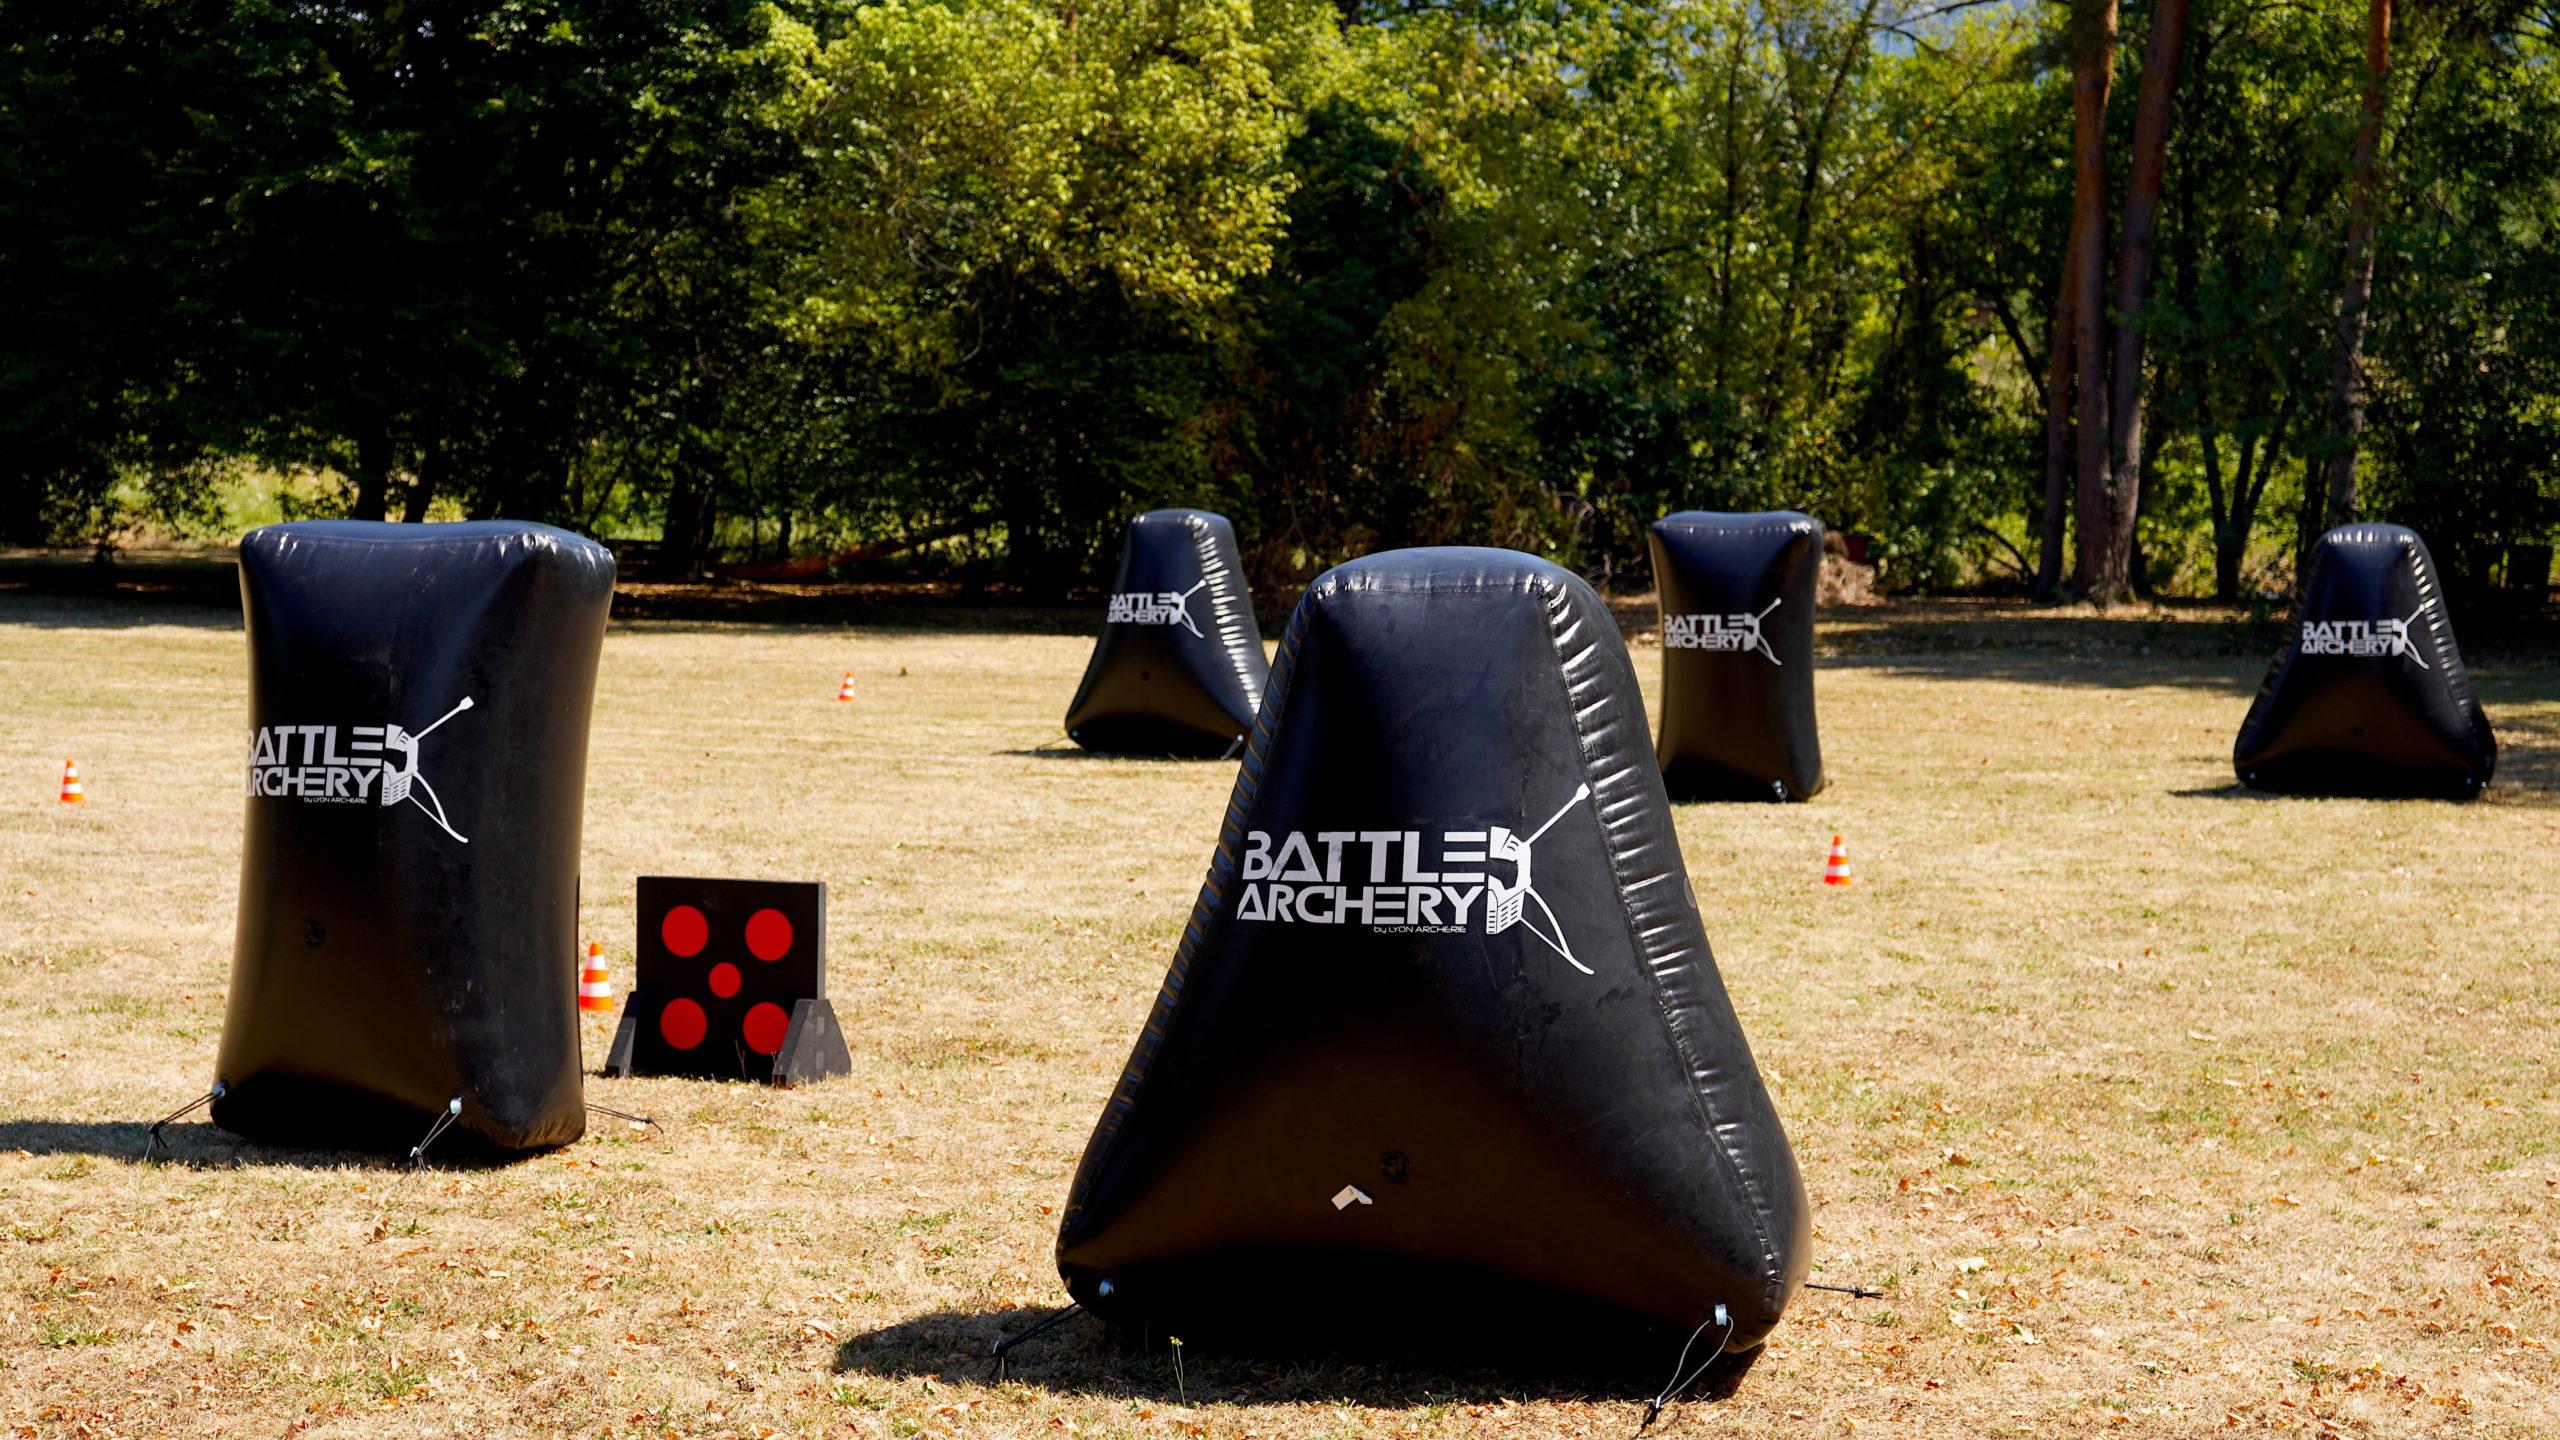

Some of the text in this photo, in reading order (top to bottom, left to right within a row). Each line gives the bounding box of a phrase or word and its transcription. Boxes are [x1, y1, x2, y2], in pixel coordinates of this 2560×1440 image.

[1109, 592, 1171, 611] BATTLE
[1107, 610, 1169, 623] ARCHERY
[1664, 614, 1744, 634] BATTLE
[2302, 620, 2392, 640] BATTLE
[1664, 634, 1743, 649] ARCHERY
[2301, 640, 2391, 654] ARCHERY
[1242, 831, 1487, 883] BATTLE
[1237, 883, 1484, 925] ARCHERY
[1374, 926, 1386, 934] by
